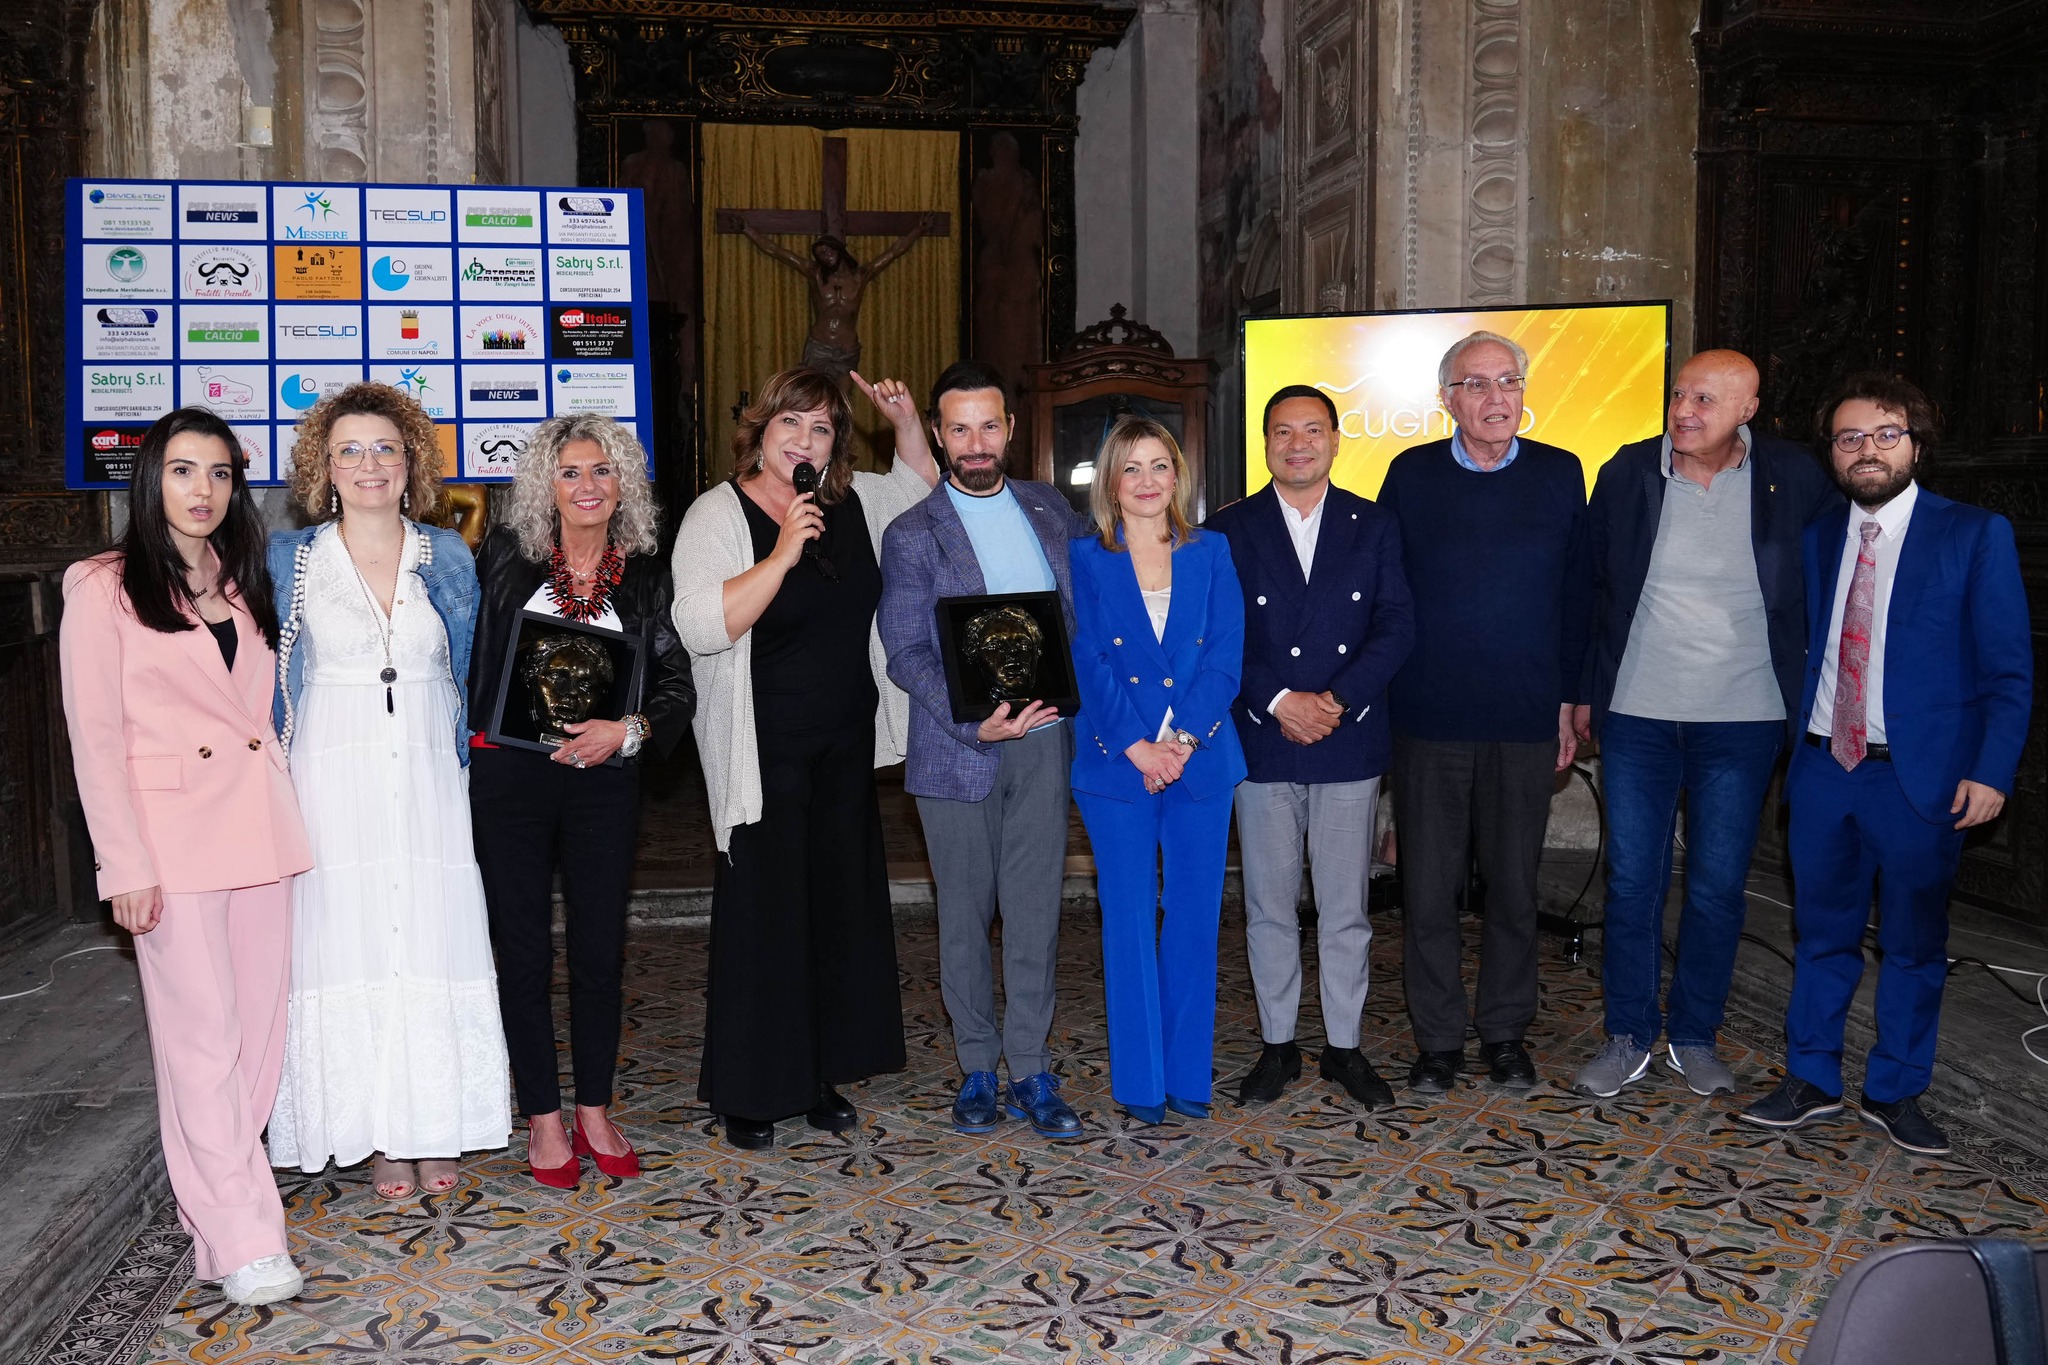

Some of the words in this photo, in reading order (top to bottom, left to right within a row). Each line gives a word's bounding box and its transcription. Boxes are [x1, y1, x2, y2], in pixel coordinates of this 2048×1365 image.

[205, 212, 239, 221] NEWS
[369, 209, 446, 222] TECSUD
[481, 216, 517, 226] CALCIO
[556, 256, 593, 271] Sabry
[597, 256, 623, 269] S.r.l.
[559, 312, 584, 324] card
[585, 313, 620, 324] Italia
[279, 325, 358, 337] TECSUD
[466, 329, 477, 339] LA
[476, 316, 493, 327] VOCE
[496, 313, 517, 321] DEGLI
[518, 318, 538, 339] ULTIMI
[205, 331, 243, 341] CALCIO
[91, 372, 132, 388] Sabry
[136, 372, 165, 386] S.r.l.
[489, 391, 520, 399] NEWS
[92, 433, 119, 445] card
[244, 436, 263, 458] ULTIMI
